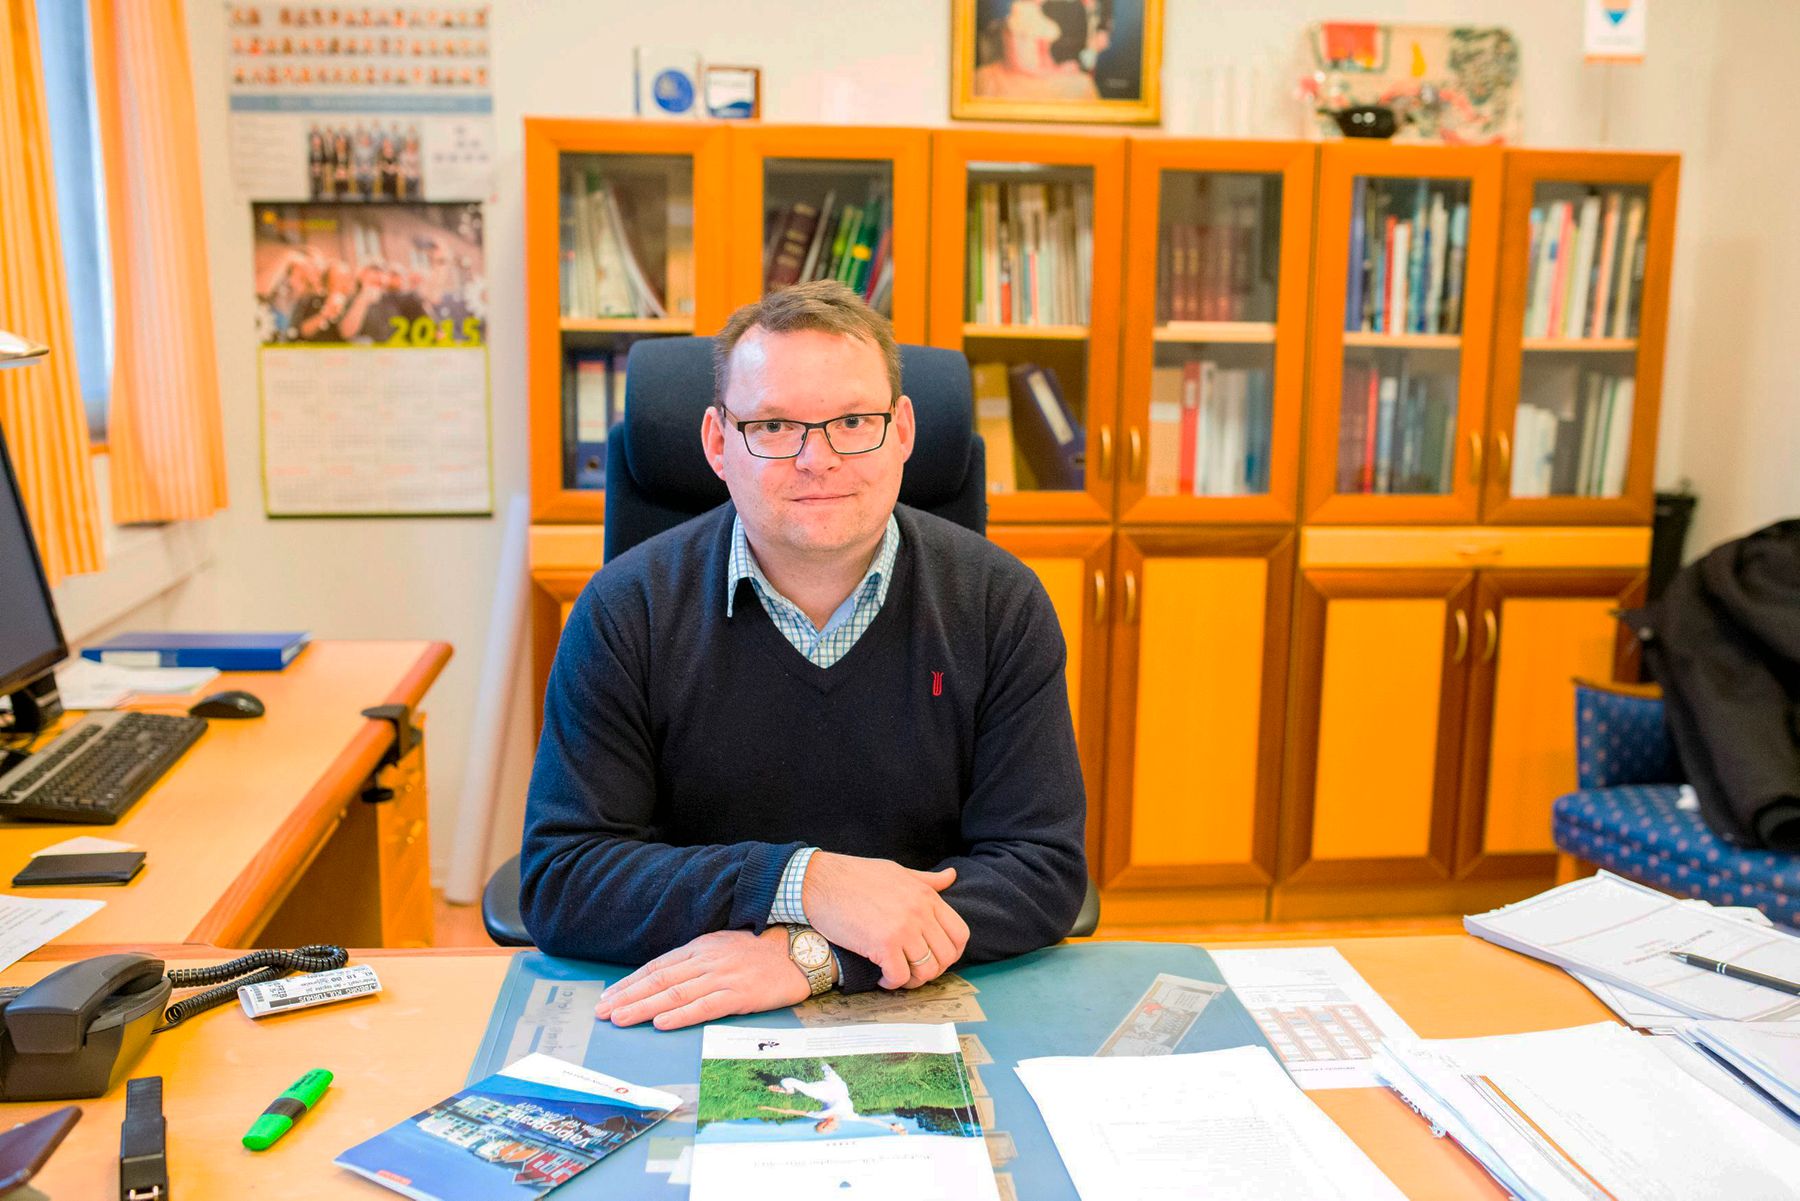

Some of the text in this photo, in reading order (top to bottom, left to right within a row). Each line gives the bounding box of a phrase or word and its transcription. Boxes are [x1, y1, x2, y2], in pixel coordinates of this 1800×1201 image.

[389, 316, 480, 348] 2015
[299, 990, 342, 1003] KULTURHUS
[507, 1110, 593, 1149] Valprogram
